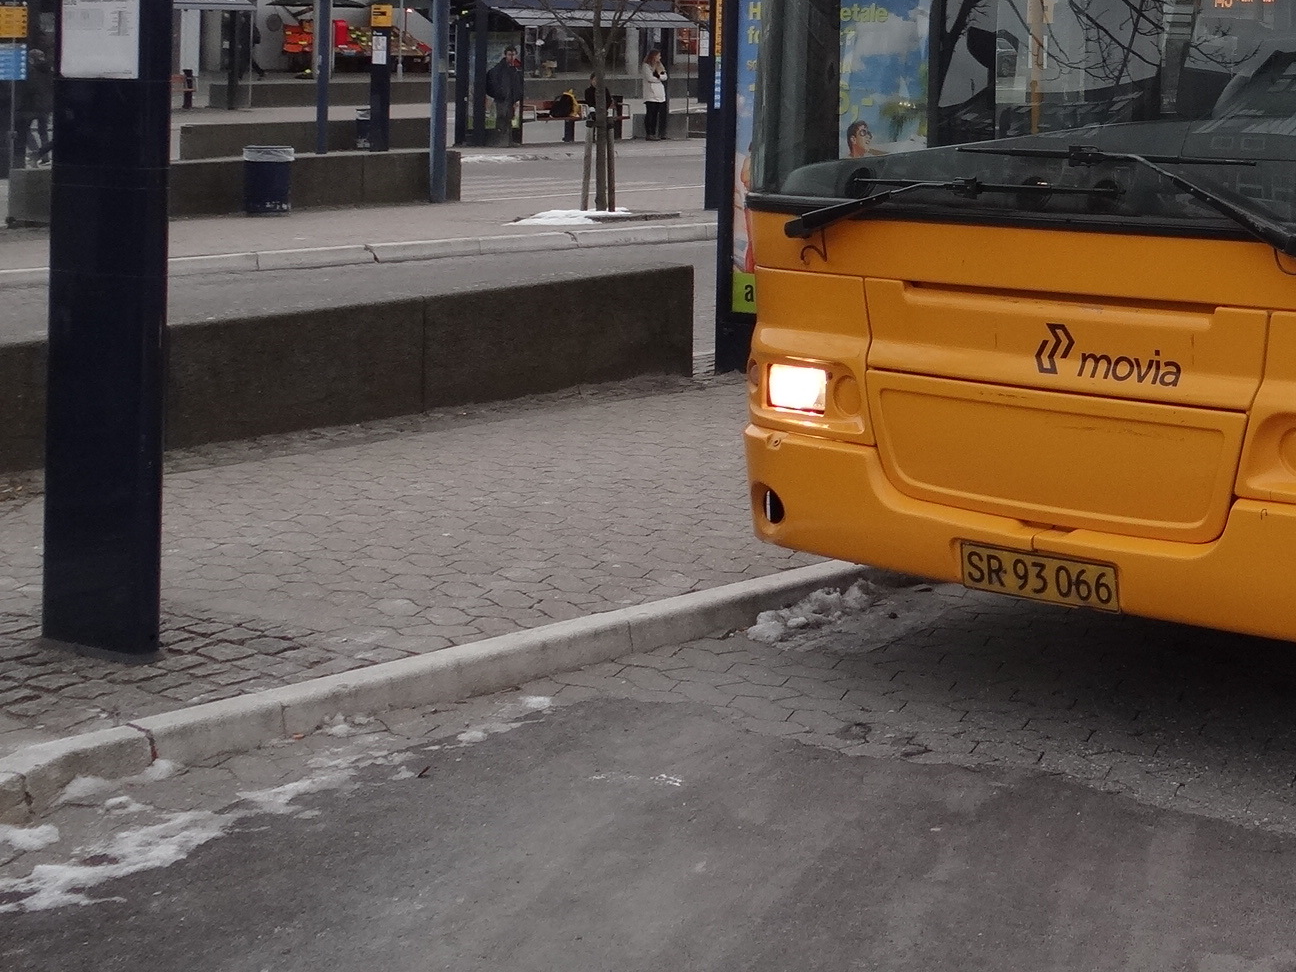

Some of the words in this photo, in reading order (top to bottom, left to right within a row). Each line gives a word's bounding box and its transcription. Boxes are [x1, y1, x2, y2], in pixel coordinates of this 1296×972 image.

[840, 2, 888, 23] etale
[1075, 349, 1183, 388] movia
[967, 550, 1006, 588] SR
[1012, 558, 1049, 594] 93
[1055, 564, 1113, 605] 066
